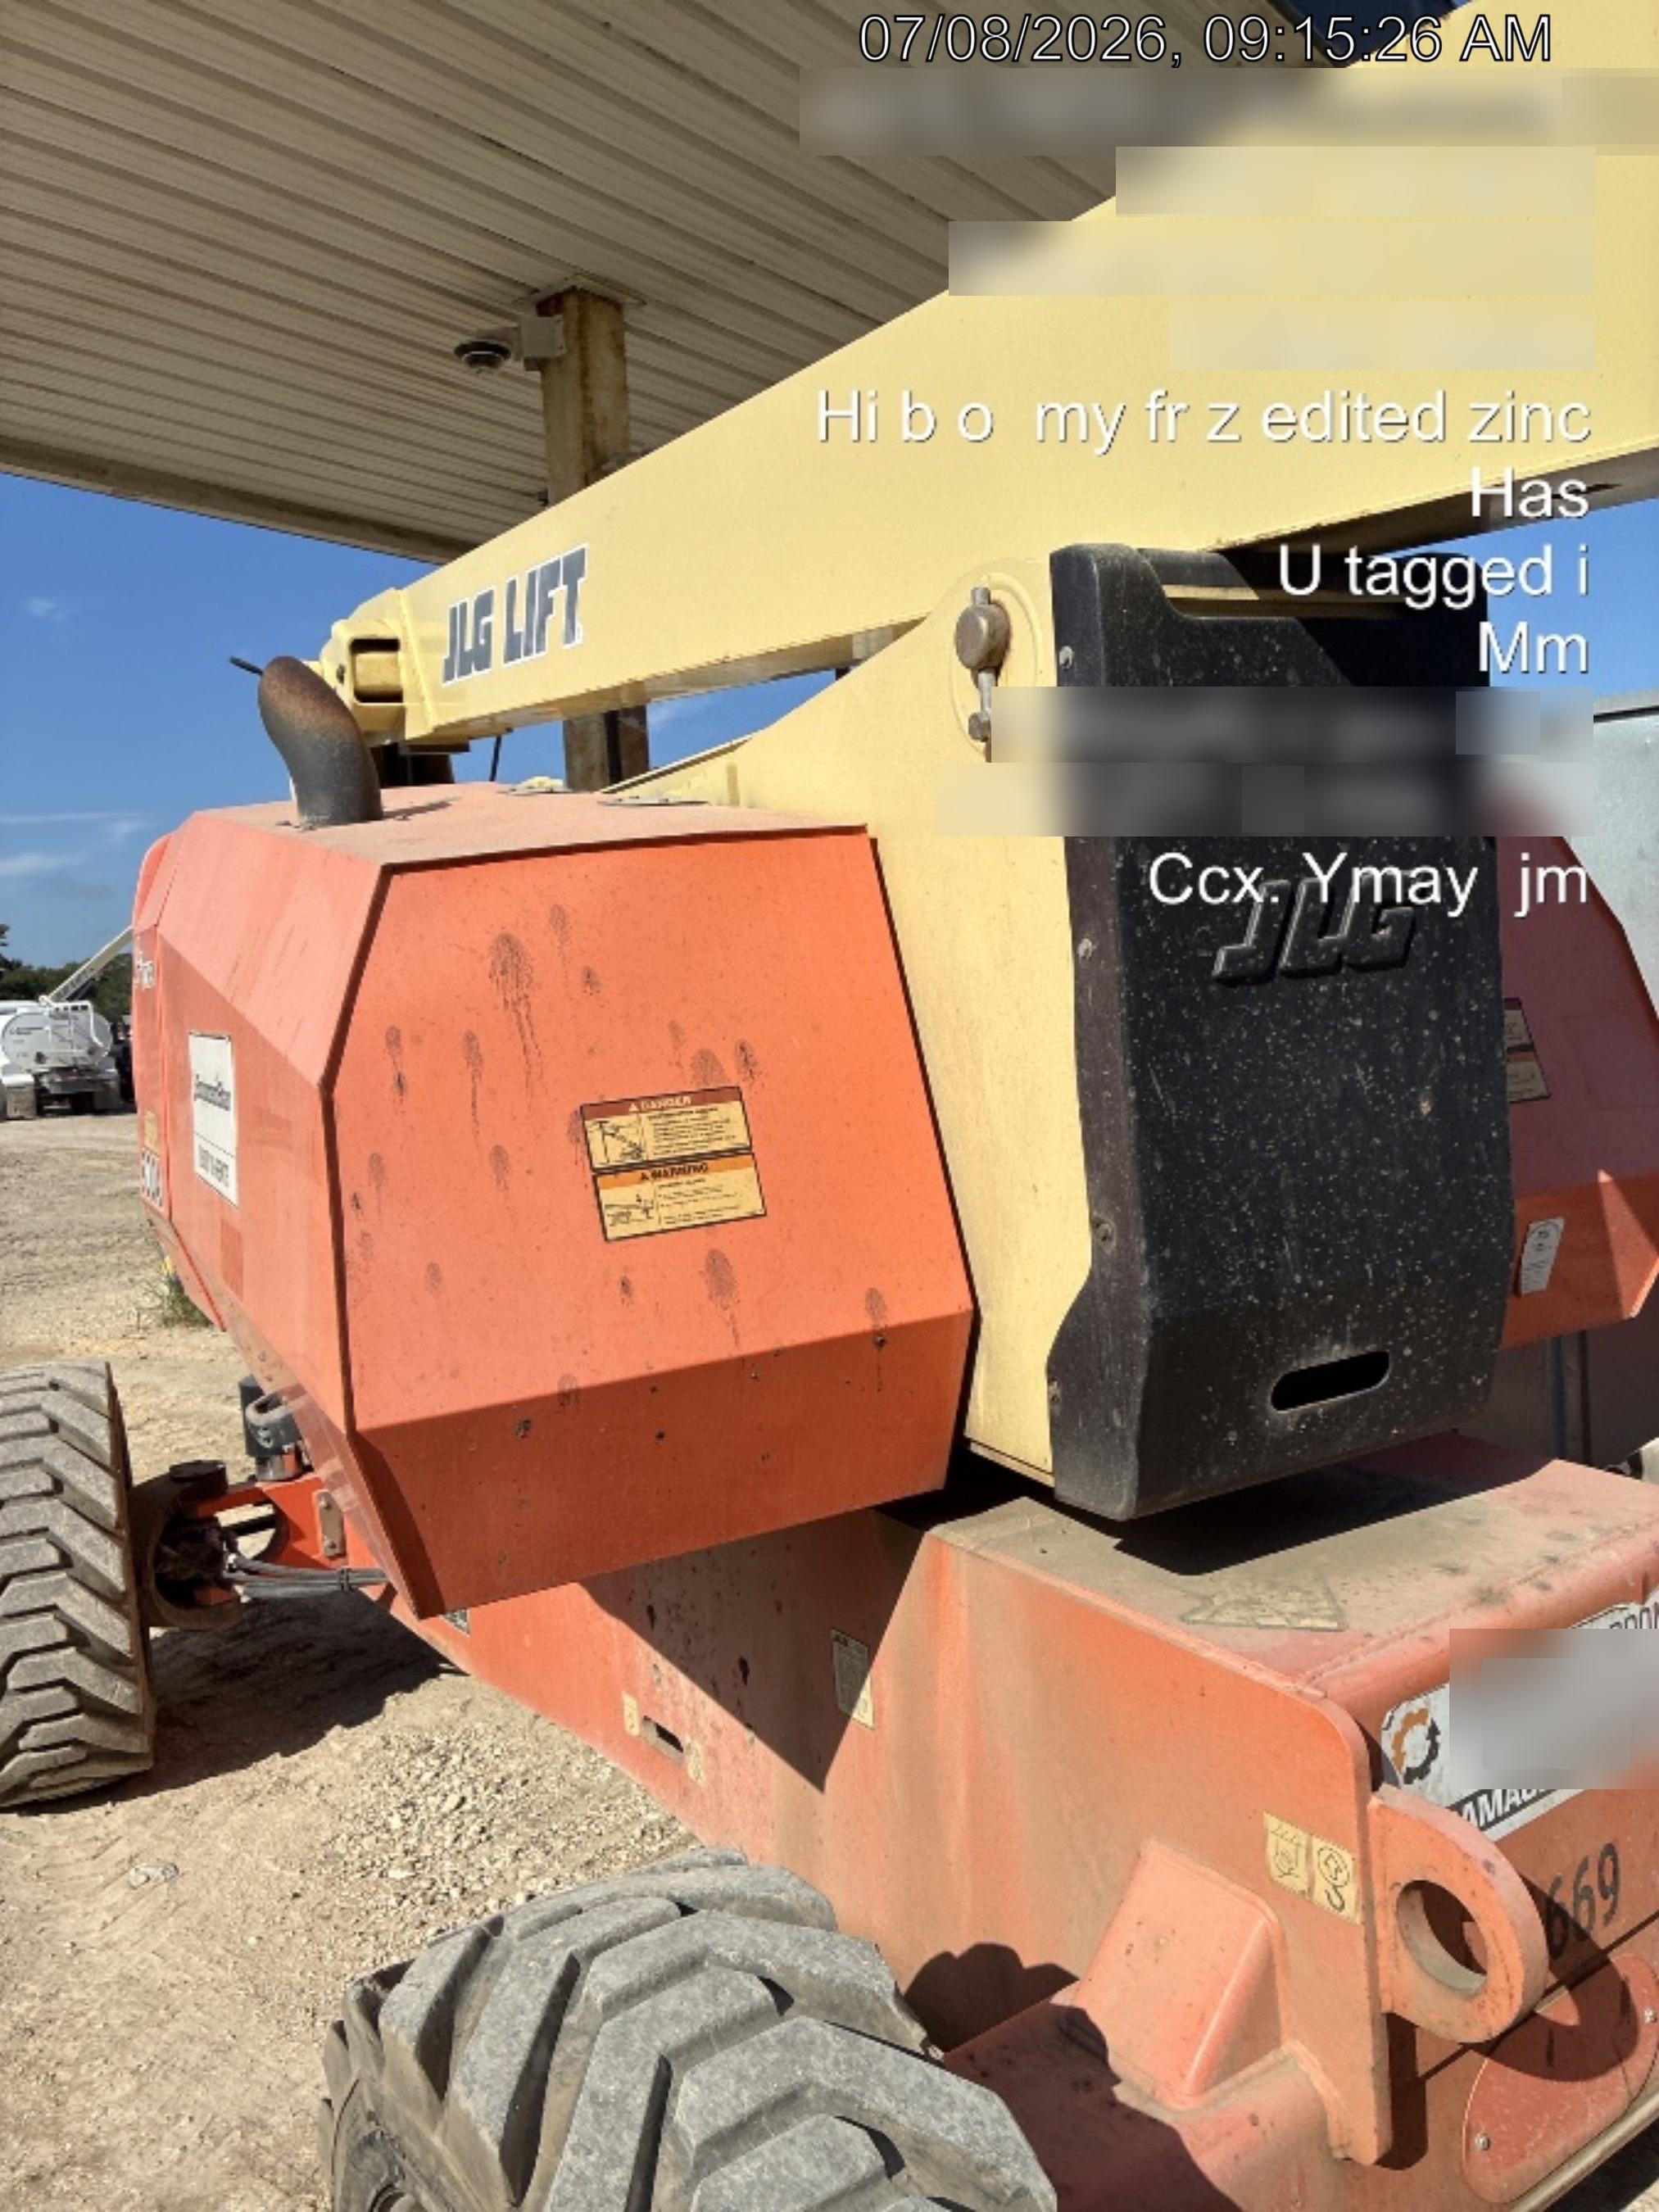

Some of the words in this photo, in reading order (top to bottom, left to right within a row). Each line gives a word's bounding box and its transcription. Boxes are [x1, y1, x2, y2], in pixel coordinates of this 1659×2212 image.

[442, 585, 496, 687] JLG
[502, 543, 588, 668] LIFT
[1212, 868, 1416, 986] JLG
[650, 1163, 709, 1179] WARNING
